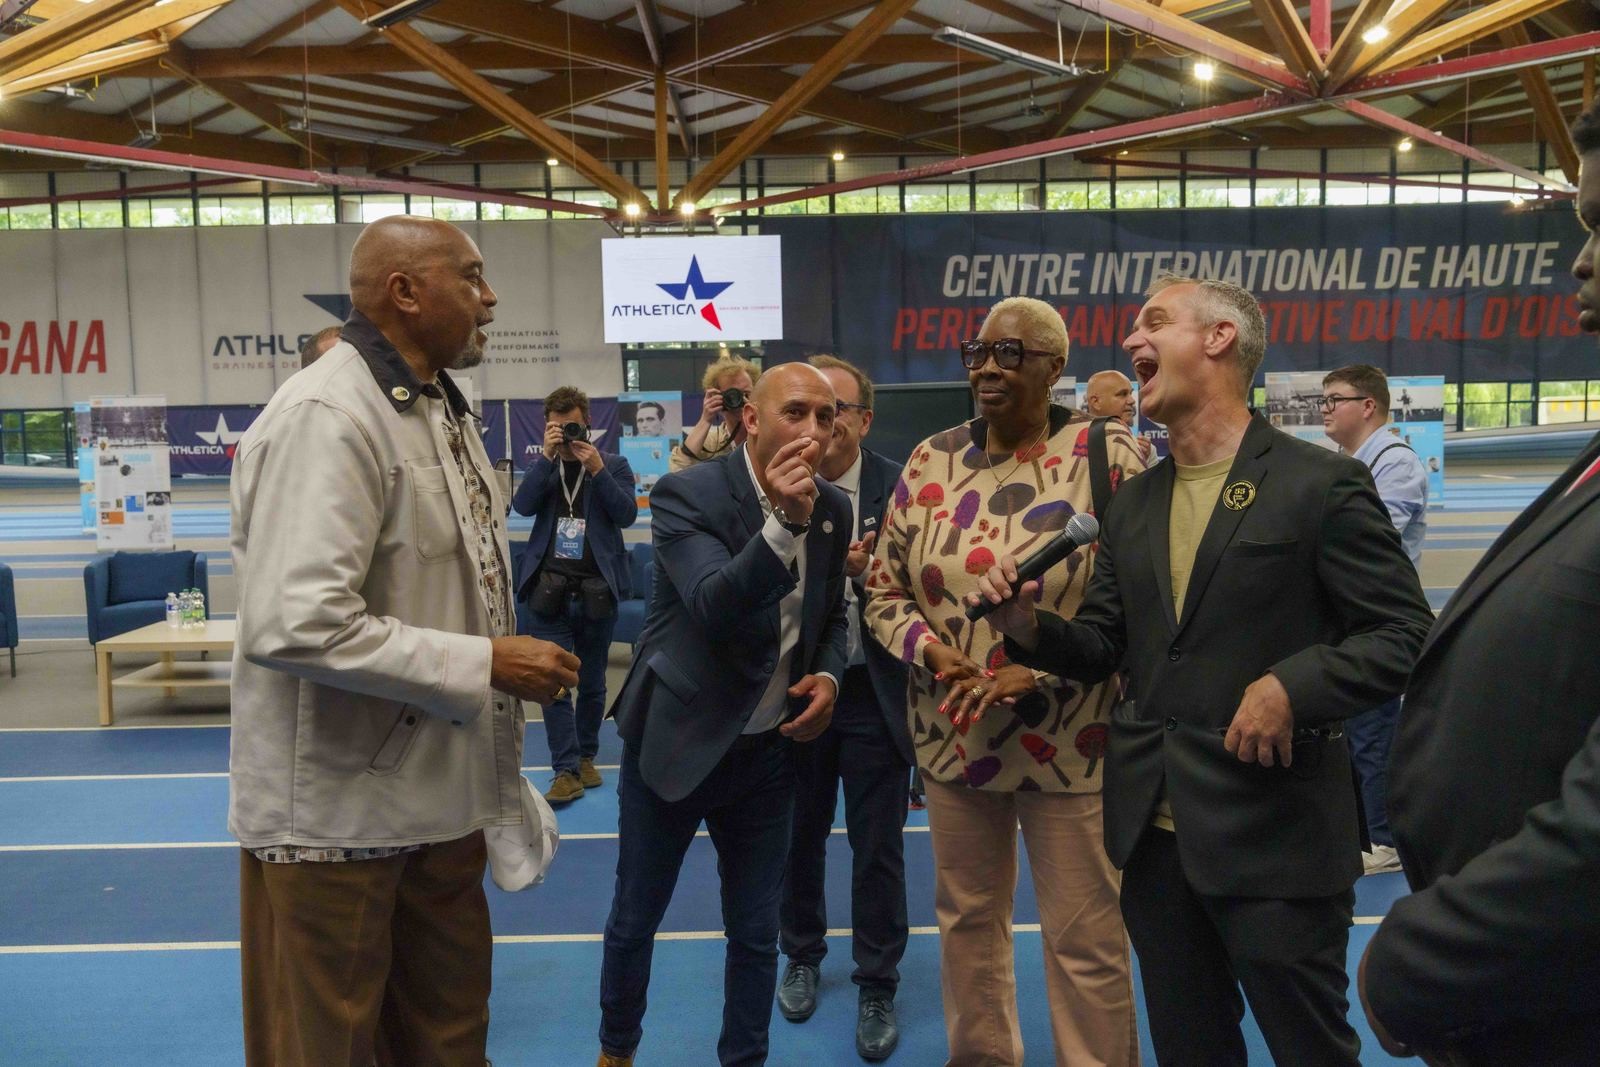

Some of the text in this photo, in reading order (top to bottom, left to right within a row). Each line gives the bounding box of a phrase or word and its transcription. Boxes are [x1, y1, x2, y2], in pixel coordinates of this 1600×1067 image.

[942, 241, 1560, 298] CENTRE INTERNATIONAL DE HAUTE
[612, 304, 696, 317] ATHLETICA
[1349, 299, 1402, 343] DU
[1408, 297, 1472, 342] VAL
[1479, 294, 1588, 340] D'OIS
[491, 342, 560, 351] PERFORMANCE
[212, 361, 298, 370] GRAINES DE
[168, 445, 224, 455] ATHLETICA
